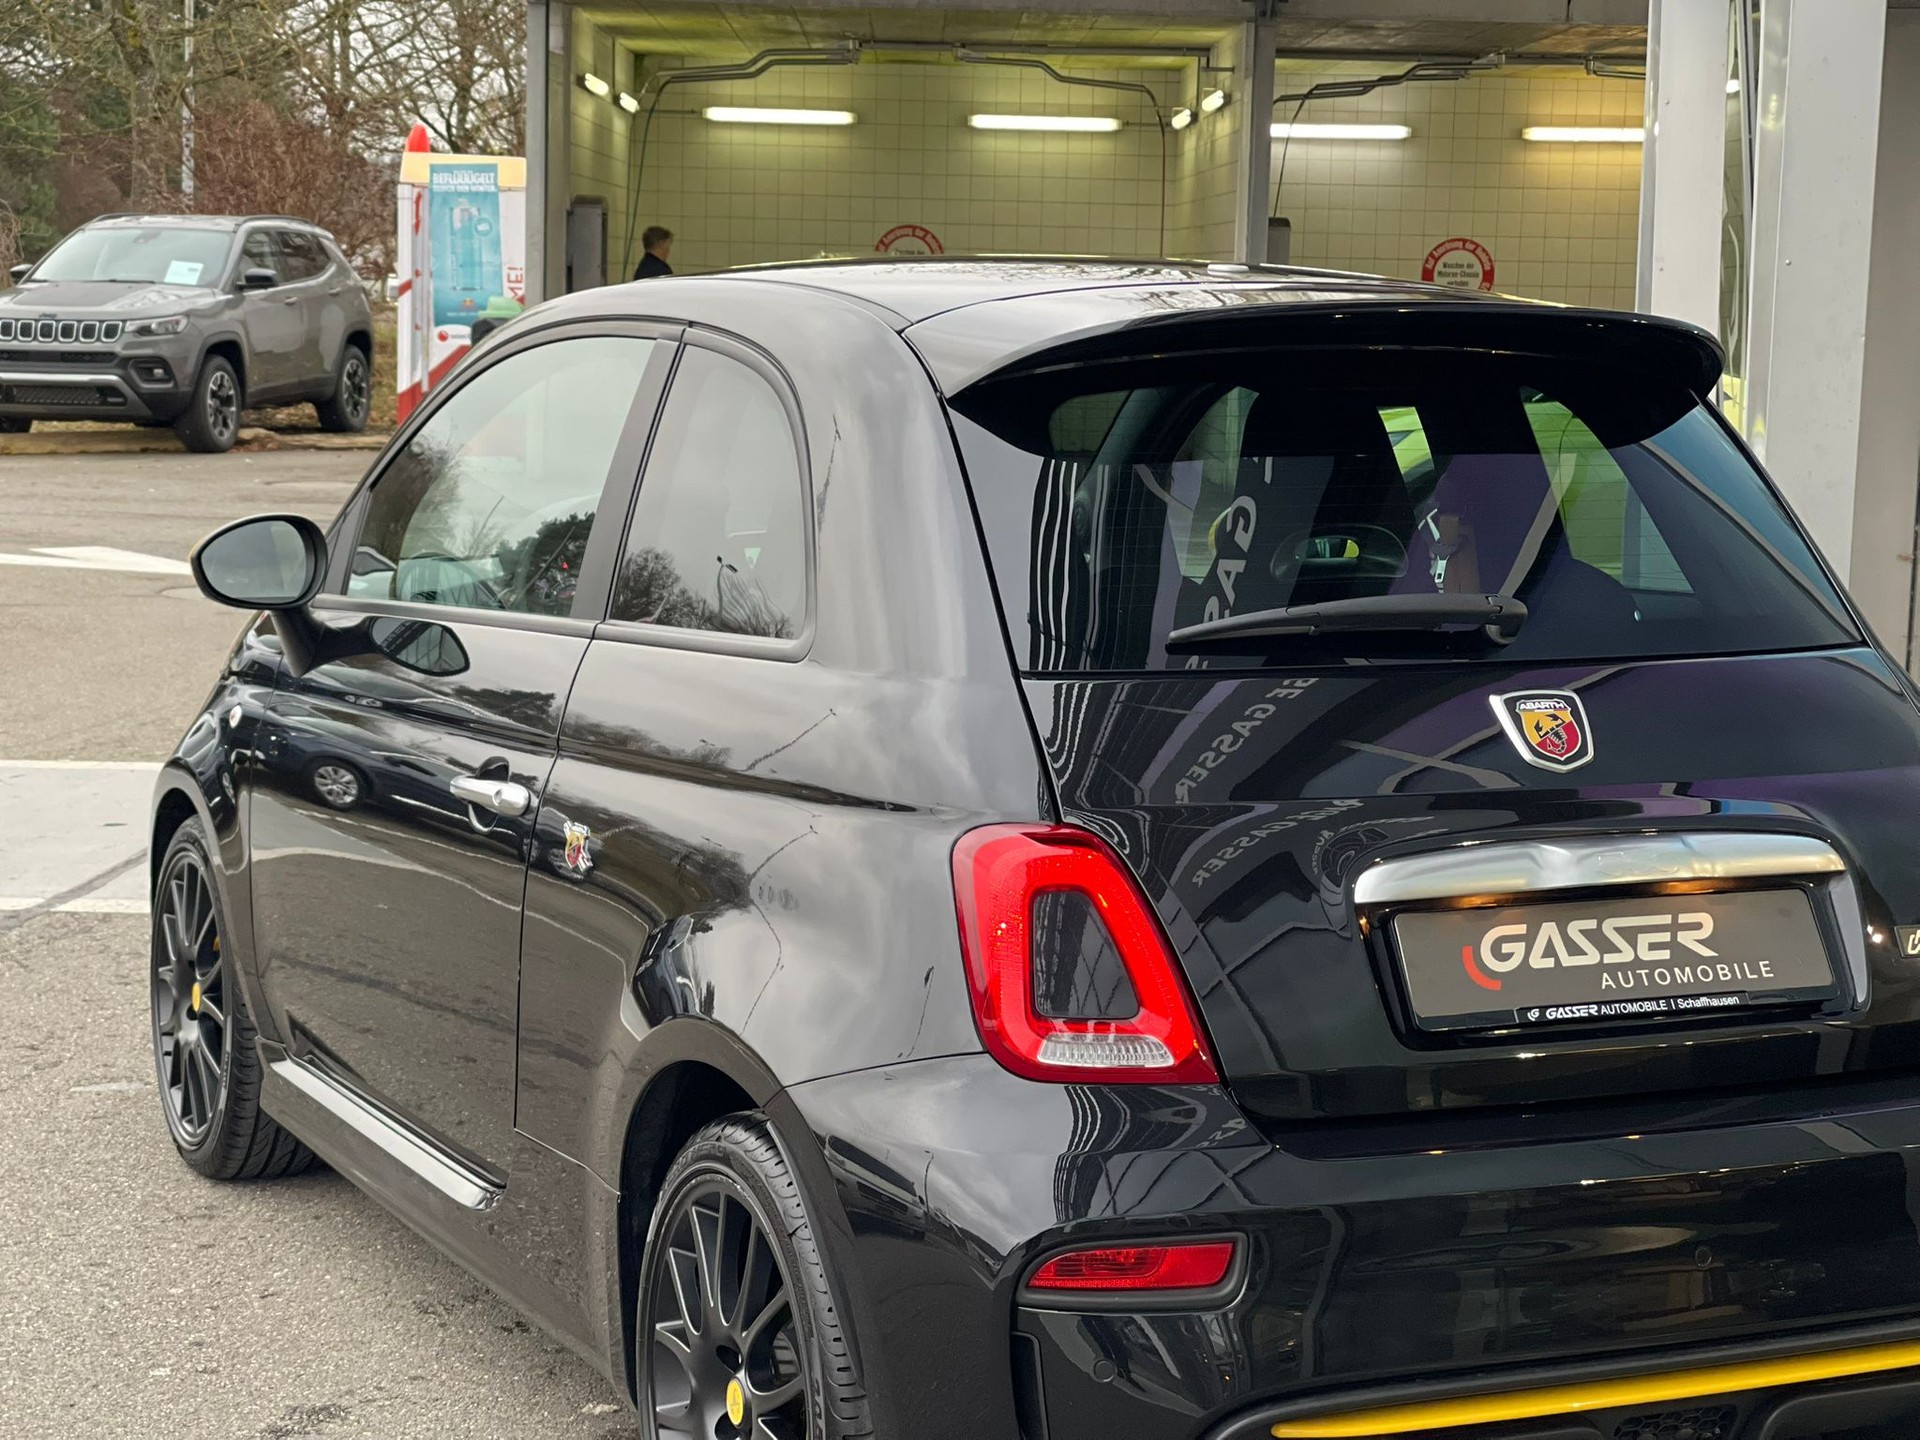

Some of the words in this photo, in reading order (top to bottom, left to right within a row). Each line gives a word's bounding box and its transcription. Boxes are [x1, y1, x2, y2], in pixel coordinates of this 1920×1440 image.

[1479, 911, 1719, 974] GASSER
[1601, 960, 1776, 990] AUTOMOBILE
[1545, 1004, 1600, 1020] GASSER
[1600, 999, 1668, 1015] AUTOMOBILE
[1677, 996, 1740, 1009] Schaffhausen
